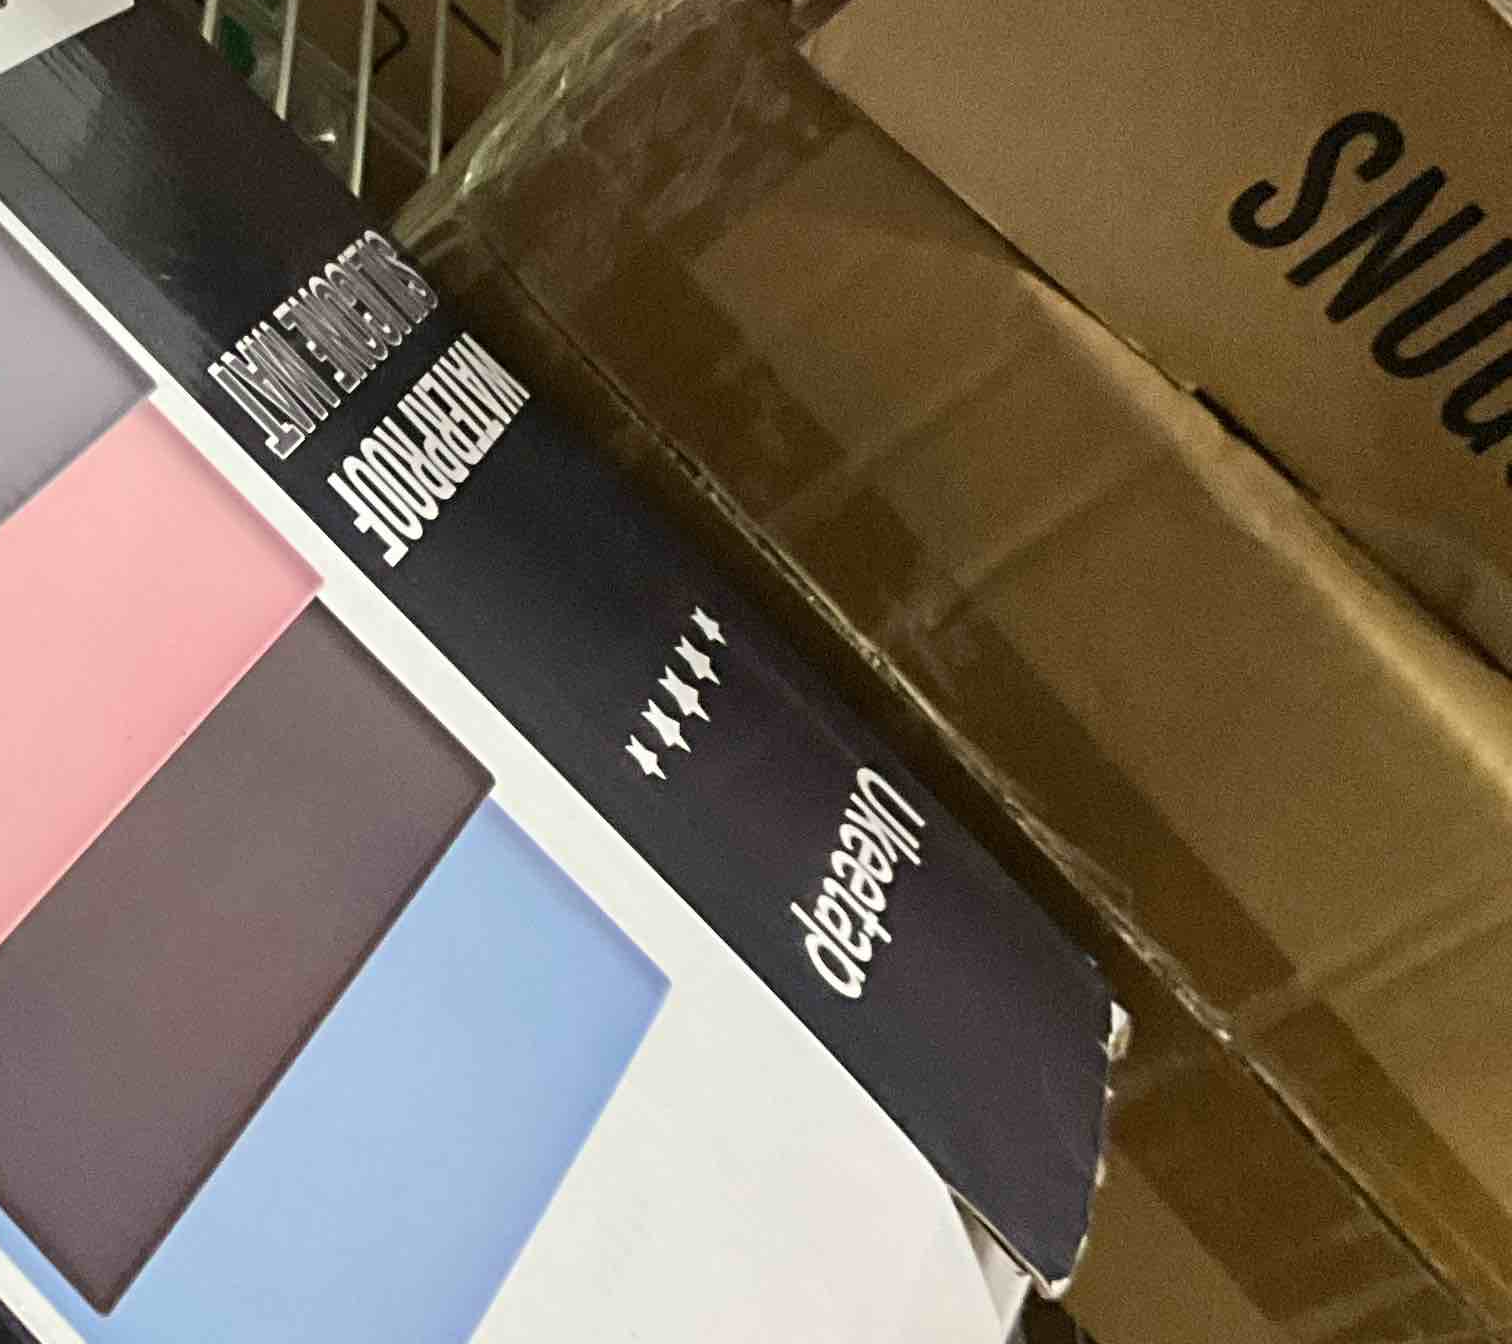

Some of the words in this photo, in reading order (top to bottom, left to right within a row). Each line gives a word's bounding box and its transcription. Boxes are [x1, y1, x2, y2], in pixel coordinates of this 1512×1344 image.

[207, 321, 341, 460] MAT
[273, 229, 438, 394] SILICONE
[327, 332, 531, 568] WATERPROOF
[791, 767, 926, 999] Ukeetap
